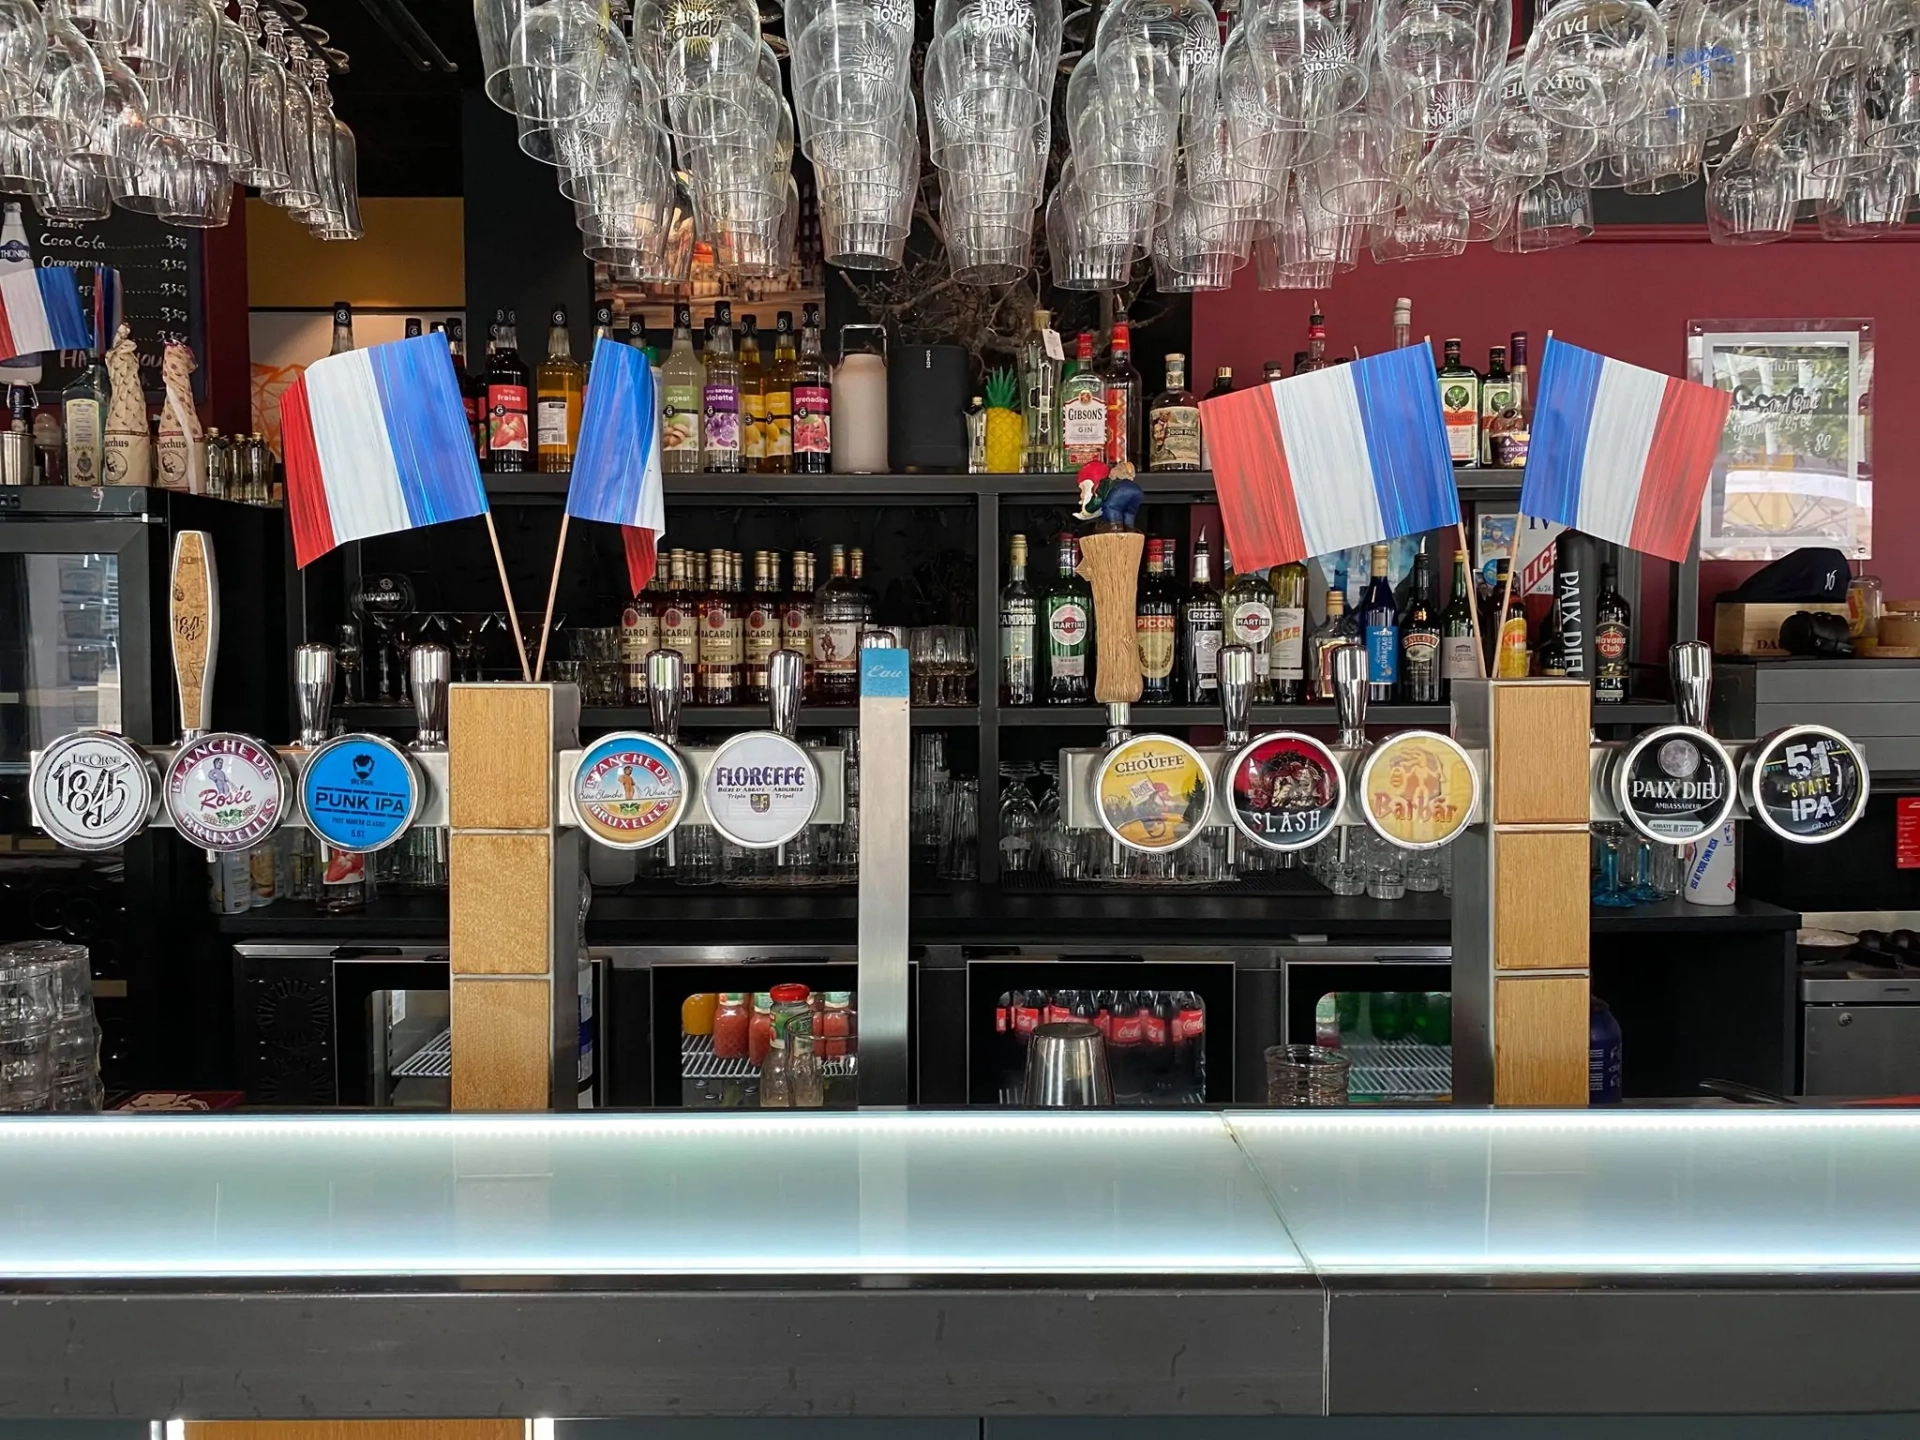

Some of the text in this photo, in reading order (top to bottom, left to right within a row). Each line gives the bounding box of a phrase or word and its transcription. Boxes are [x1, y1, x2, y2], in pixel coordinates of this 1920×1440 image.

[40, 233, 72, 246] Coca
[75, 235, 106, 249] Cola
[706, 394, 734, 402] violette
[795, 396, 829, 405] grenadine
[1068, 408, 1103, 420] GIBSON'S
[1560, 571, 1582, 625] PAIX
[1054, 621, 1084, 629] MARTINI
[1137, 619, 1174, 628] PICON
[1236, 618, 1269, 626] MARTINI
[624, 627, 648, 637] CARDÍ
[1403, 634, 1437, 647] BAILEYS
[1596, 635, 1626, 644] Havana
[1601, 644, 1620, 652] Club
[867, 665, 902, 678] Eau
[1607, 663, 1615, 672] 7
[172, 740, 272, 793] BLANCHE DE
[1115, 755, 1185, 774] CHOUFFE
[654, 766, 670, 787] DE
[716, 767, 806, 787] FLOREFFE
[53, 761, 130, 830] 1845
[1633, 780, 1723, 800] PAIX DIEU
[1791, 778, 1831, 797] STATE
[198, 785, 252, 811] Rosée
[315, 792, 405, 813] PUNK IPA
[1655, 802, 1702, 810] AMBASSADEUR
[591, 799, 669, 828] BRUXELLES
[1791, 795, 1836, 821] IPA
[183, 798, 277, 844] BRUXELLES
[1253, 810, 1321, 833] SLASH
